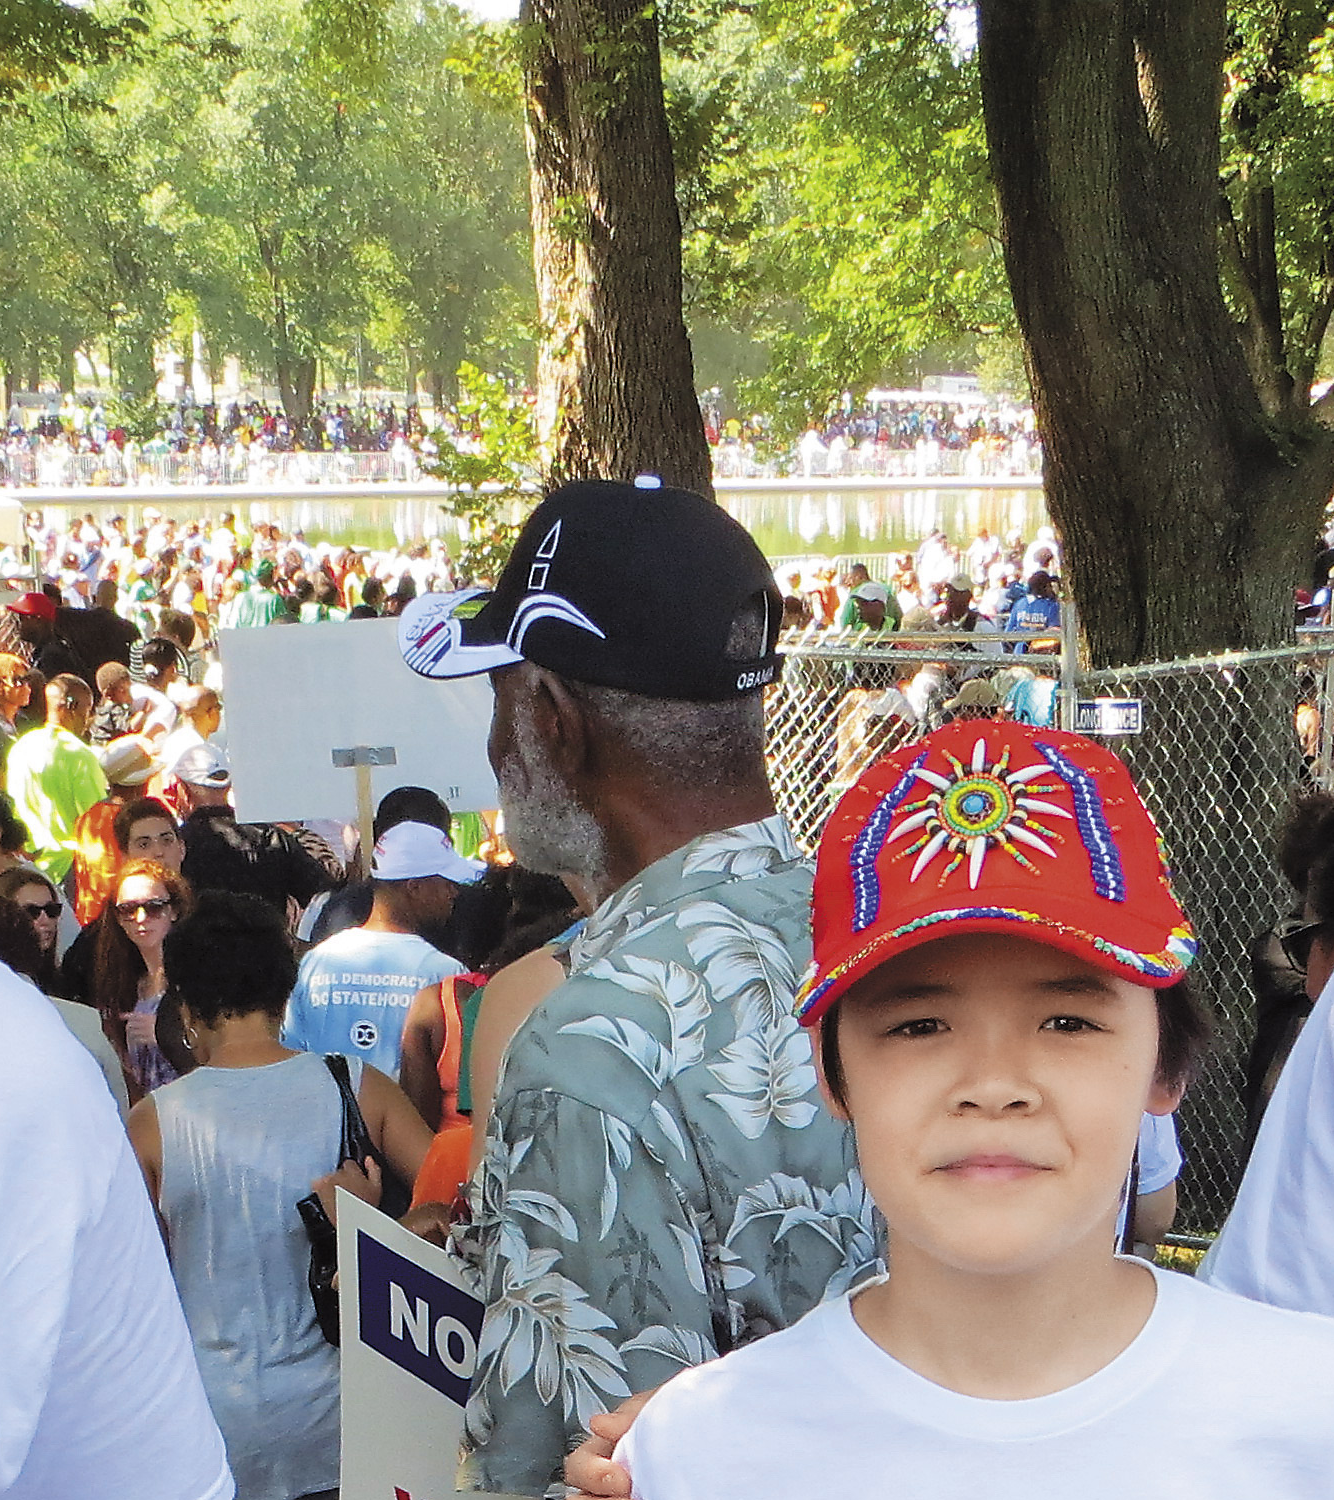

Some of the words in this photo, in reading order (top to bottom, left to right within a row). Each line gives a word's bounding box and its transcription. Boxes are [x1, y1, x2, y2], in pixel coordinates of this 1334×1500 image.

[342, 972, 427, 989] DEMOCRACY
[331, 990, 415, 1008] STATEHOO
[388, 1280, 476, 1380] NO
